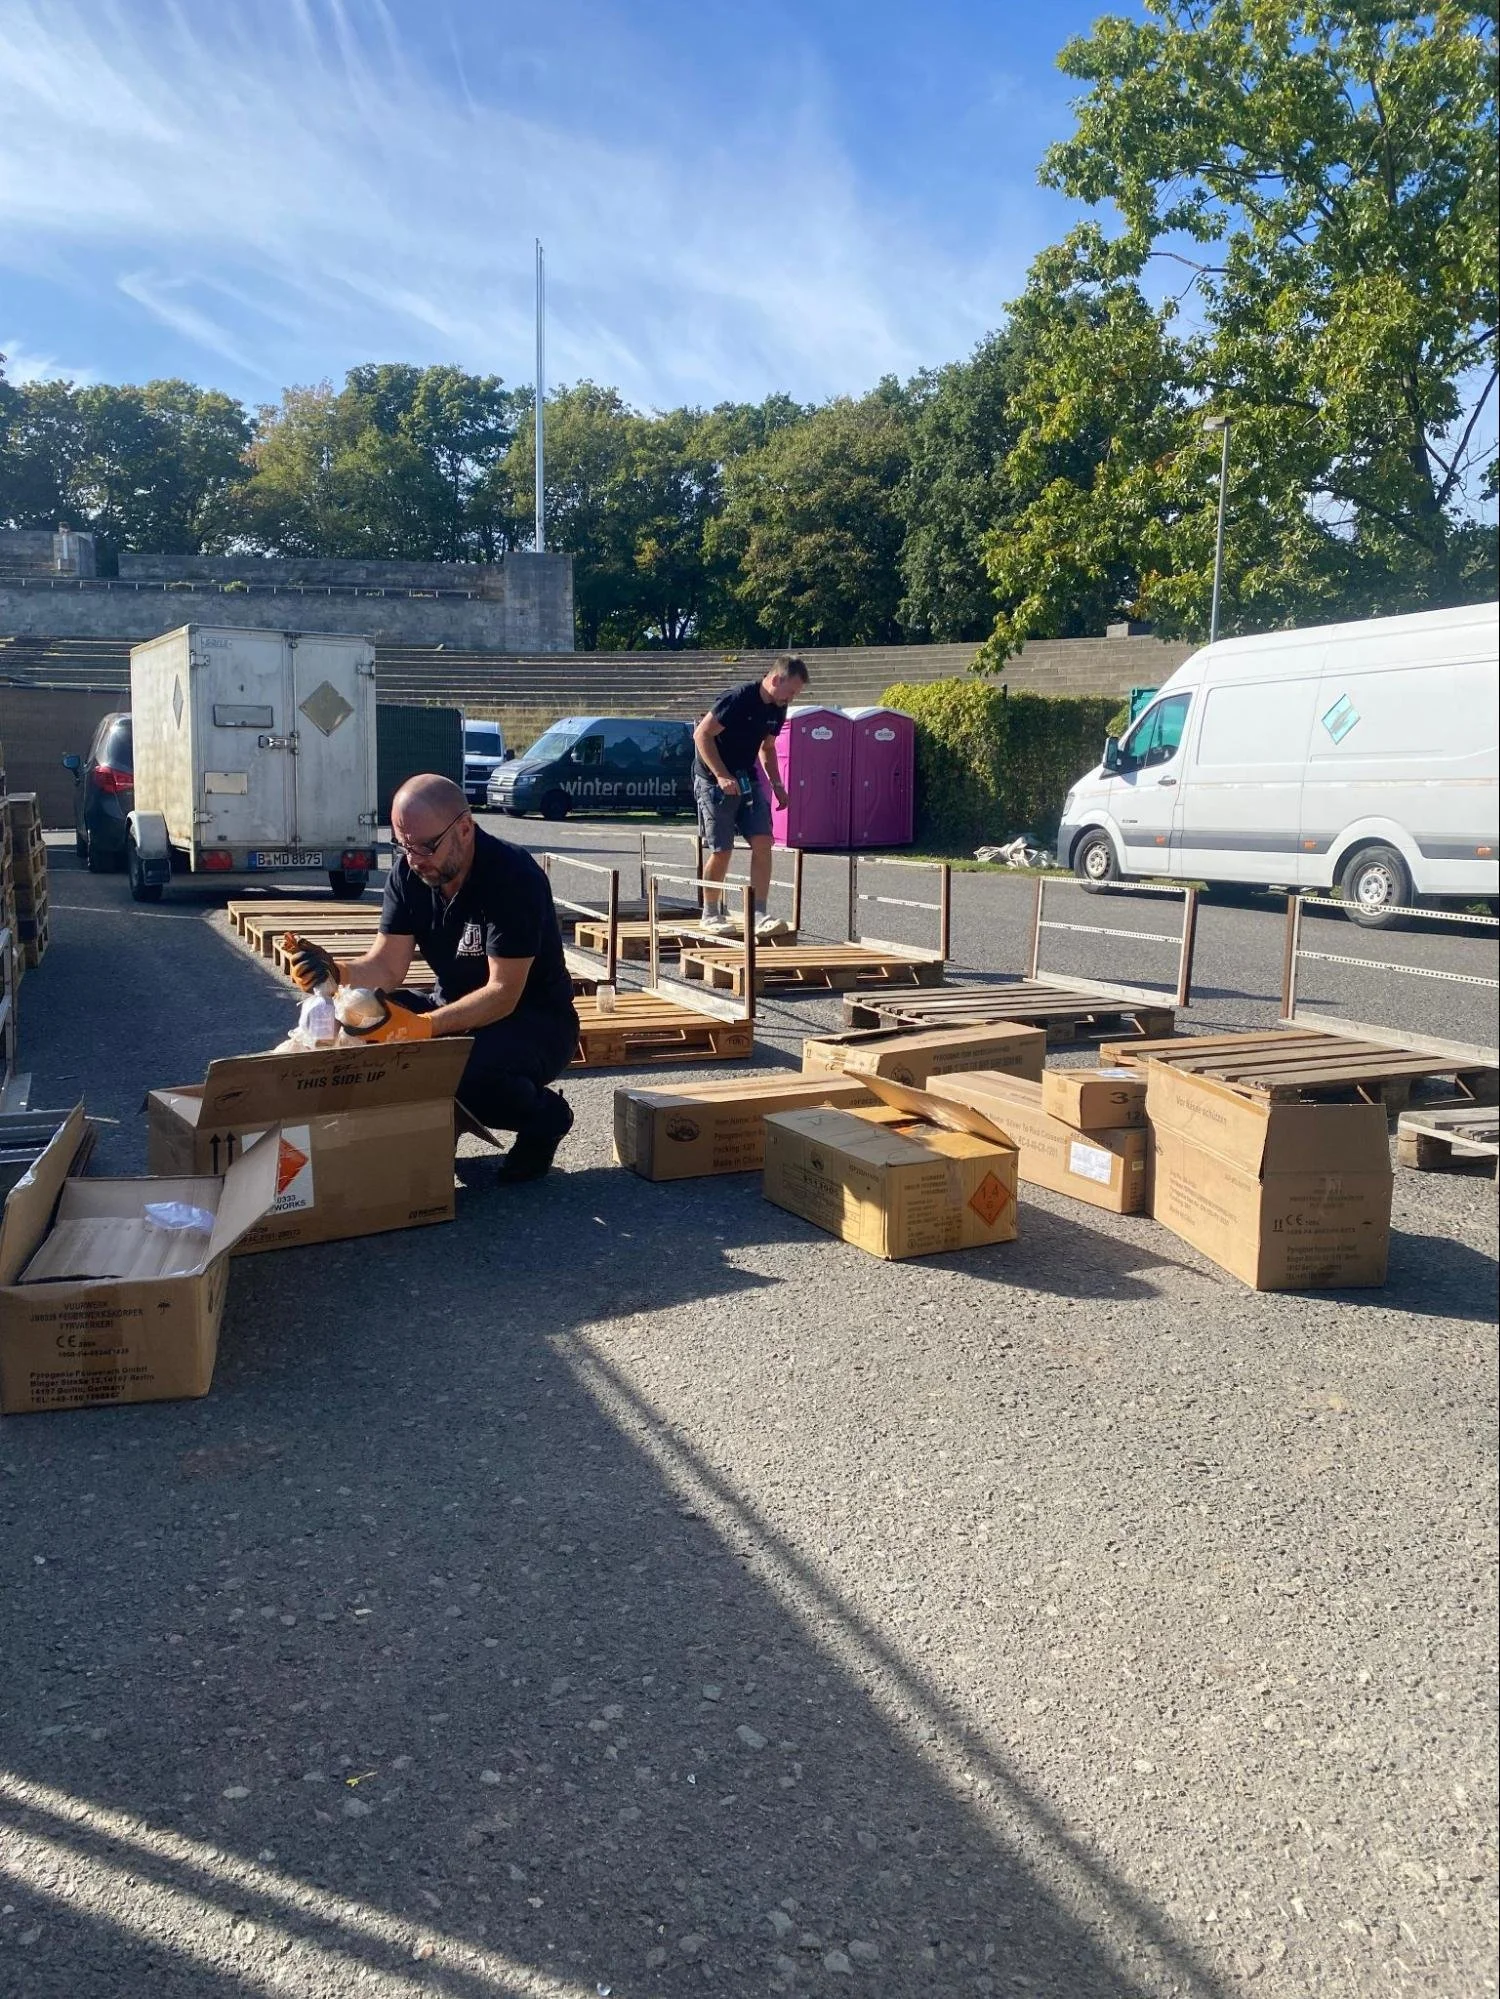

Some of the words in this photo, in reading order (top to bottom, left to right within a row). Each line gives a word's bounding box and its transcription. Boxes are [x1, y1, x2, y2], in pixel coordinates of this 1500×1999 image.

[559, 776, 622, 796] winter
[626, 776, 678, 796] outlet
[258, 854, 265, 865] B
[295, 1076, 327, 1091] THIS
[330, 1073, 362, 1087] SIDE
[364, 1070, 385, 1083] UP
[273, 1199, 306, 1211] WORKS
